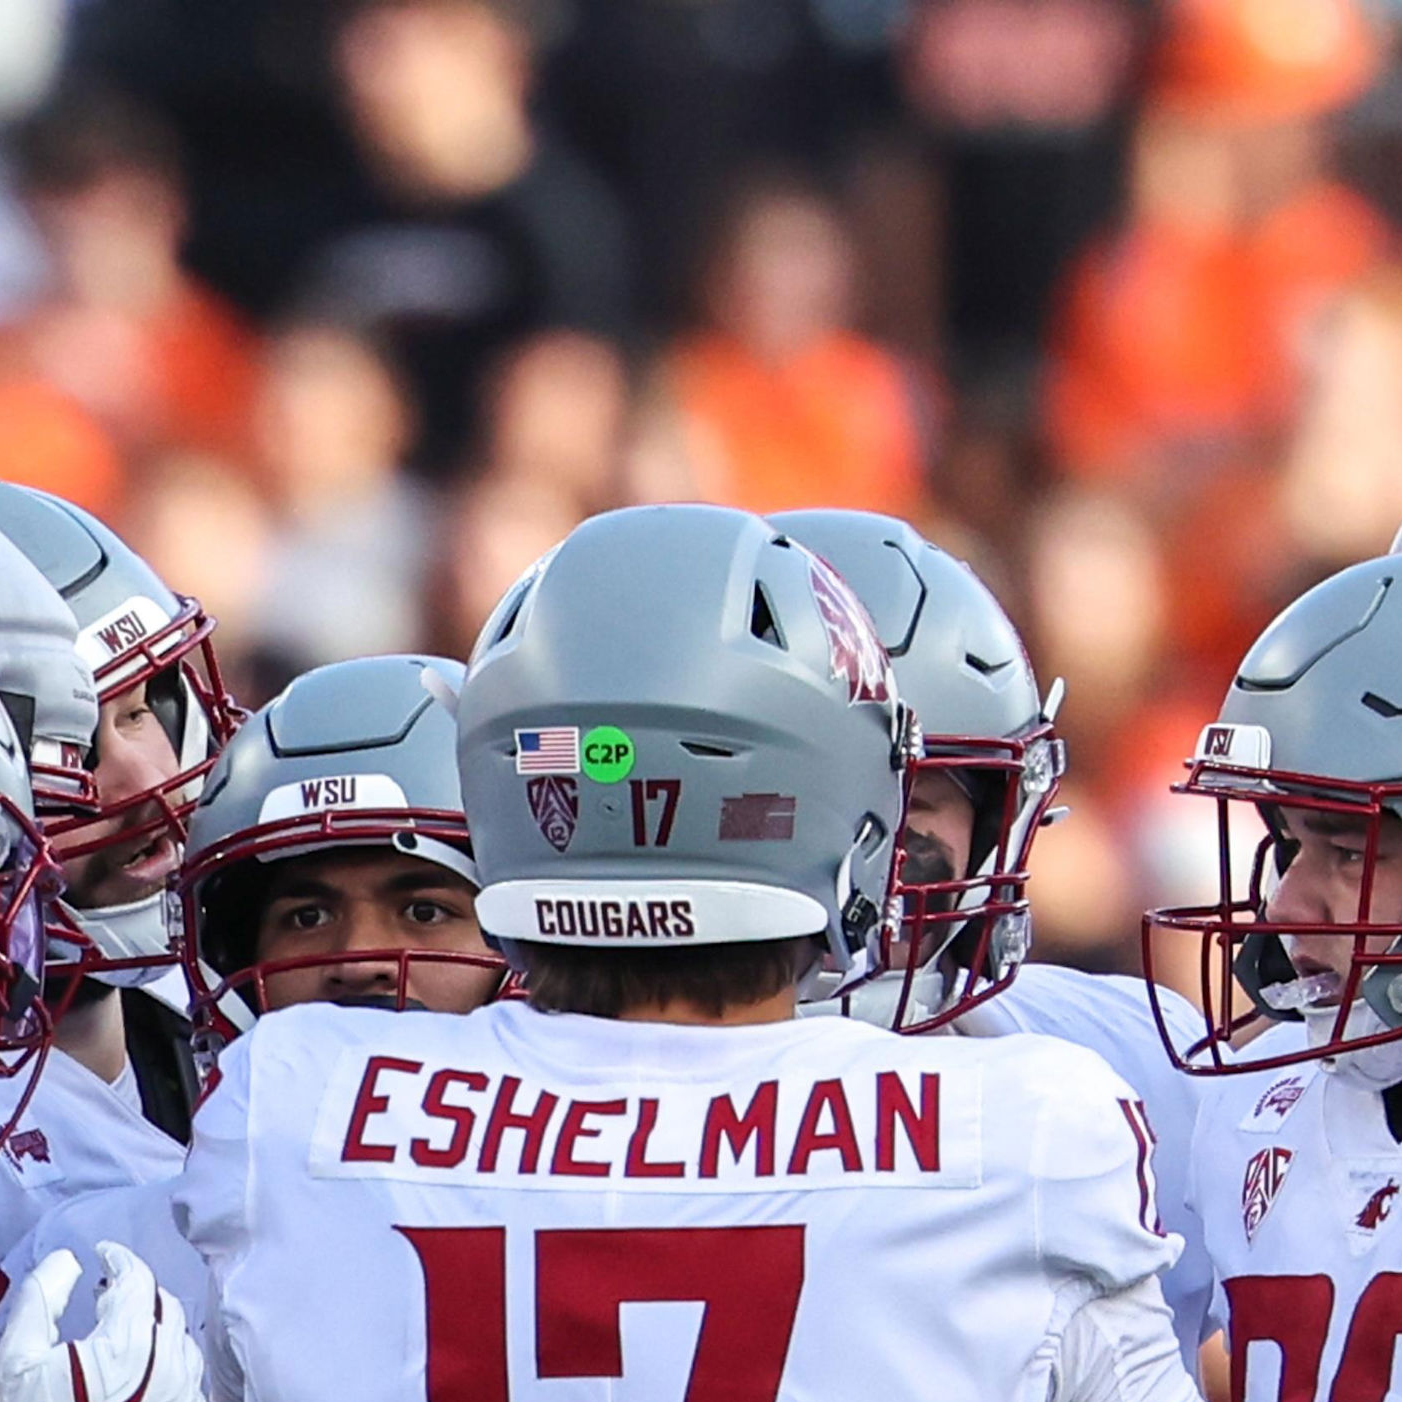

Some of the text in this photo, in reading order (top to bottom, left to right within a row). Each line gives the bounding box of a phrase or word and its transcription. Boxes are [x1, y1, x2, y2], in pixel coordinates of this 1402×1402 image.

[98, 611, 147, 654] WSU
[584, 743, 629, 764] C2P
[301, 777, 356, 808] WSU
[629, 779, 681, 847] 17
[535, 899, 695, 937] COUGARS
[341, 1055, 941, 1179] ESHELMAN
